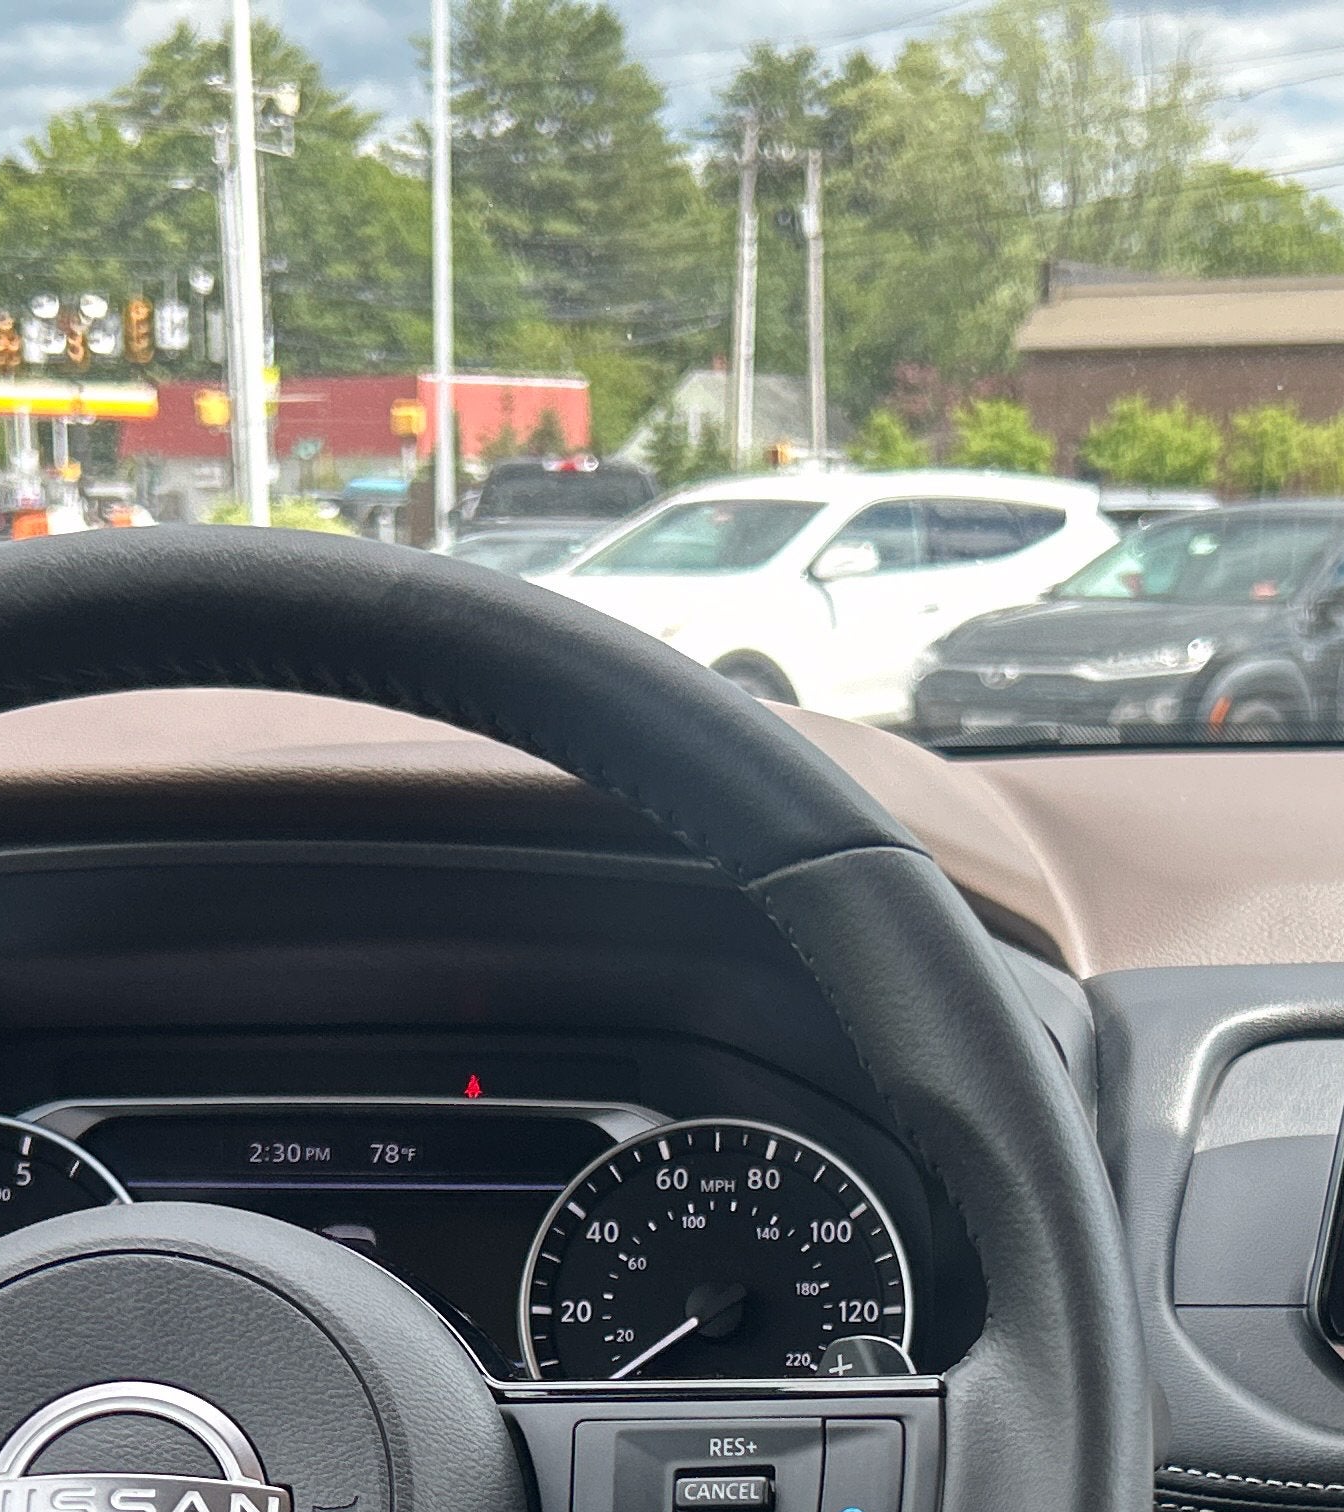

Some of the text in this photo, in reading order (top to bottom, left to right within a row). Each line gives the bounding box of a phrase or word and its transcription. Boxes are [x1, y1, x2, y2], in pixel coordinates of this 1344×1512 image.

[249, 1142, 331, 1164] 2:30 PM
[16, 1162, 32, 1188] 5
[656, 1168, 689, 1191] 60
[747, 1168, 781, 1191] 80
[700, 1178, 736, 1194] MPH
[586, 1221, 619, 1244] 40
[680, 1215, 707, 1231] 100
[810, 1220, 852, 1245] 100
[756, 1226, 780, 1242] 140
[627, 1256, 648, 1272] 60
[795, 1281, 820, 1297] 180
[561, 1300, 593, 1324] 20
[838, 1300, 879, 1324] 120
[616, 1328, 635, 1344] 20
[785, 1352, 811, 1368] 220
[684, 1483, 759, 1501] CANCEL
